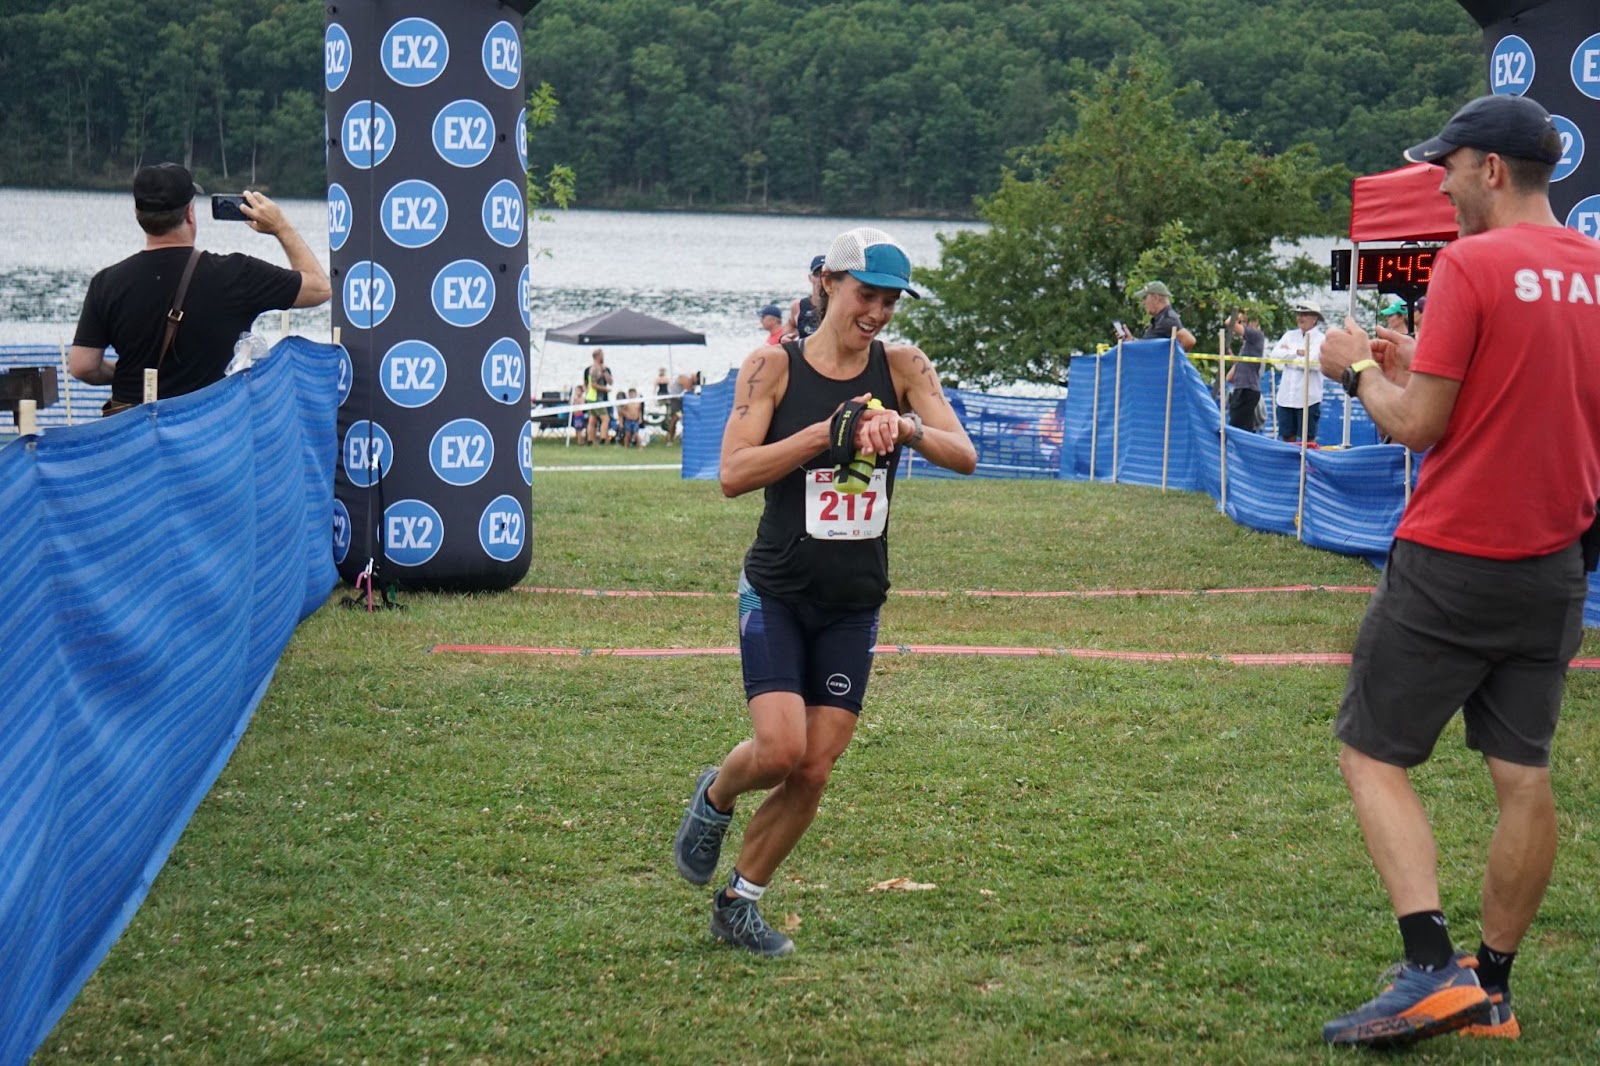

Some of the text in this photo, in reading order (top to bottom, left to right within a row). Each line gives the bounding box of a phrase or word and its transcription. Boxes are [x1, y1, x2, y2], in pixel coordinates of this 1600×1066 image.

[326, 40, 345, 74] EX2
[392, 35, 438, 69] EX2
[491, 37, 518, 74] EX2
[1495, 52, 1527, 88] EX2
[349, 118, 385, 151] EX2
[444, 117, 487, 150] EX2
[391, 197, 437, 230] EX2
[492, 196, 520, 231] EX2
[350, 278, 385, 311] EX2
[443, 276, 487, 310] EX2
[1514, 269, 1600, 306] STA
[390, 357, 436, 390] EX2
[491, 354, 521, 388] EX2
[441, 435, 485, 468] EX2
[819, 490, 877, 521] 217
[388, 516, 433, 549] EX2
[488, 512, 521, 545] EX2
